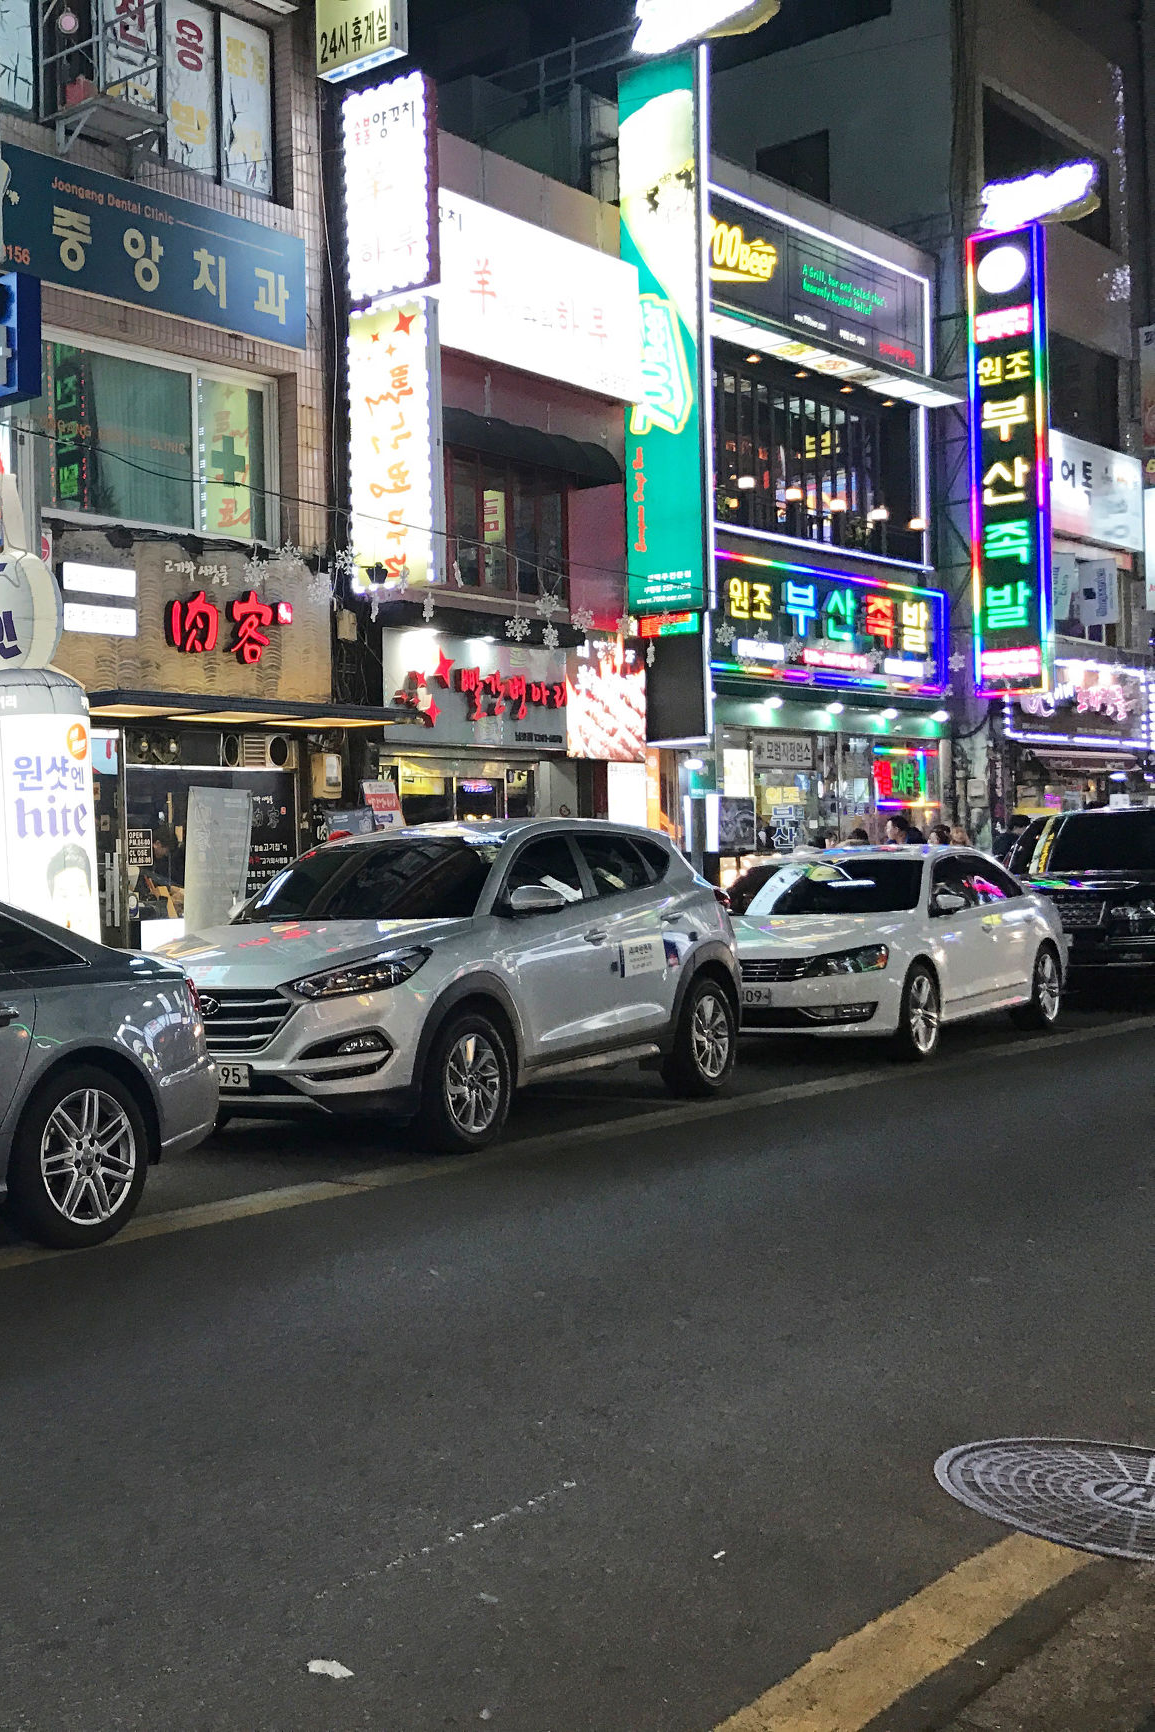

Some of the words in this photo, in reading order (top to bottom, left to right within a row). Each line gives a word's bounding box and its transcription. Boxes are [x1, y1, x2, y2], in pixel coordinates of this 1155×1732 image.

[51, 176, 105, 206] Joongang
[107, 192, 141, 216] Dental
[51, 205, 290, 325] 중앙치과
[976, 350, 1032, 387] 원조
[728, 577, 774, 621] 원조
[784, 578, 929, 654] 부산족발
[14, 794, 88, 839] hite
[219, 1066, 242, 1085] 95
